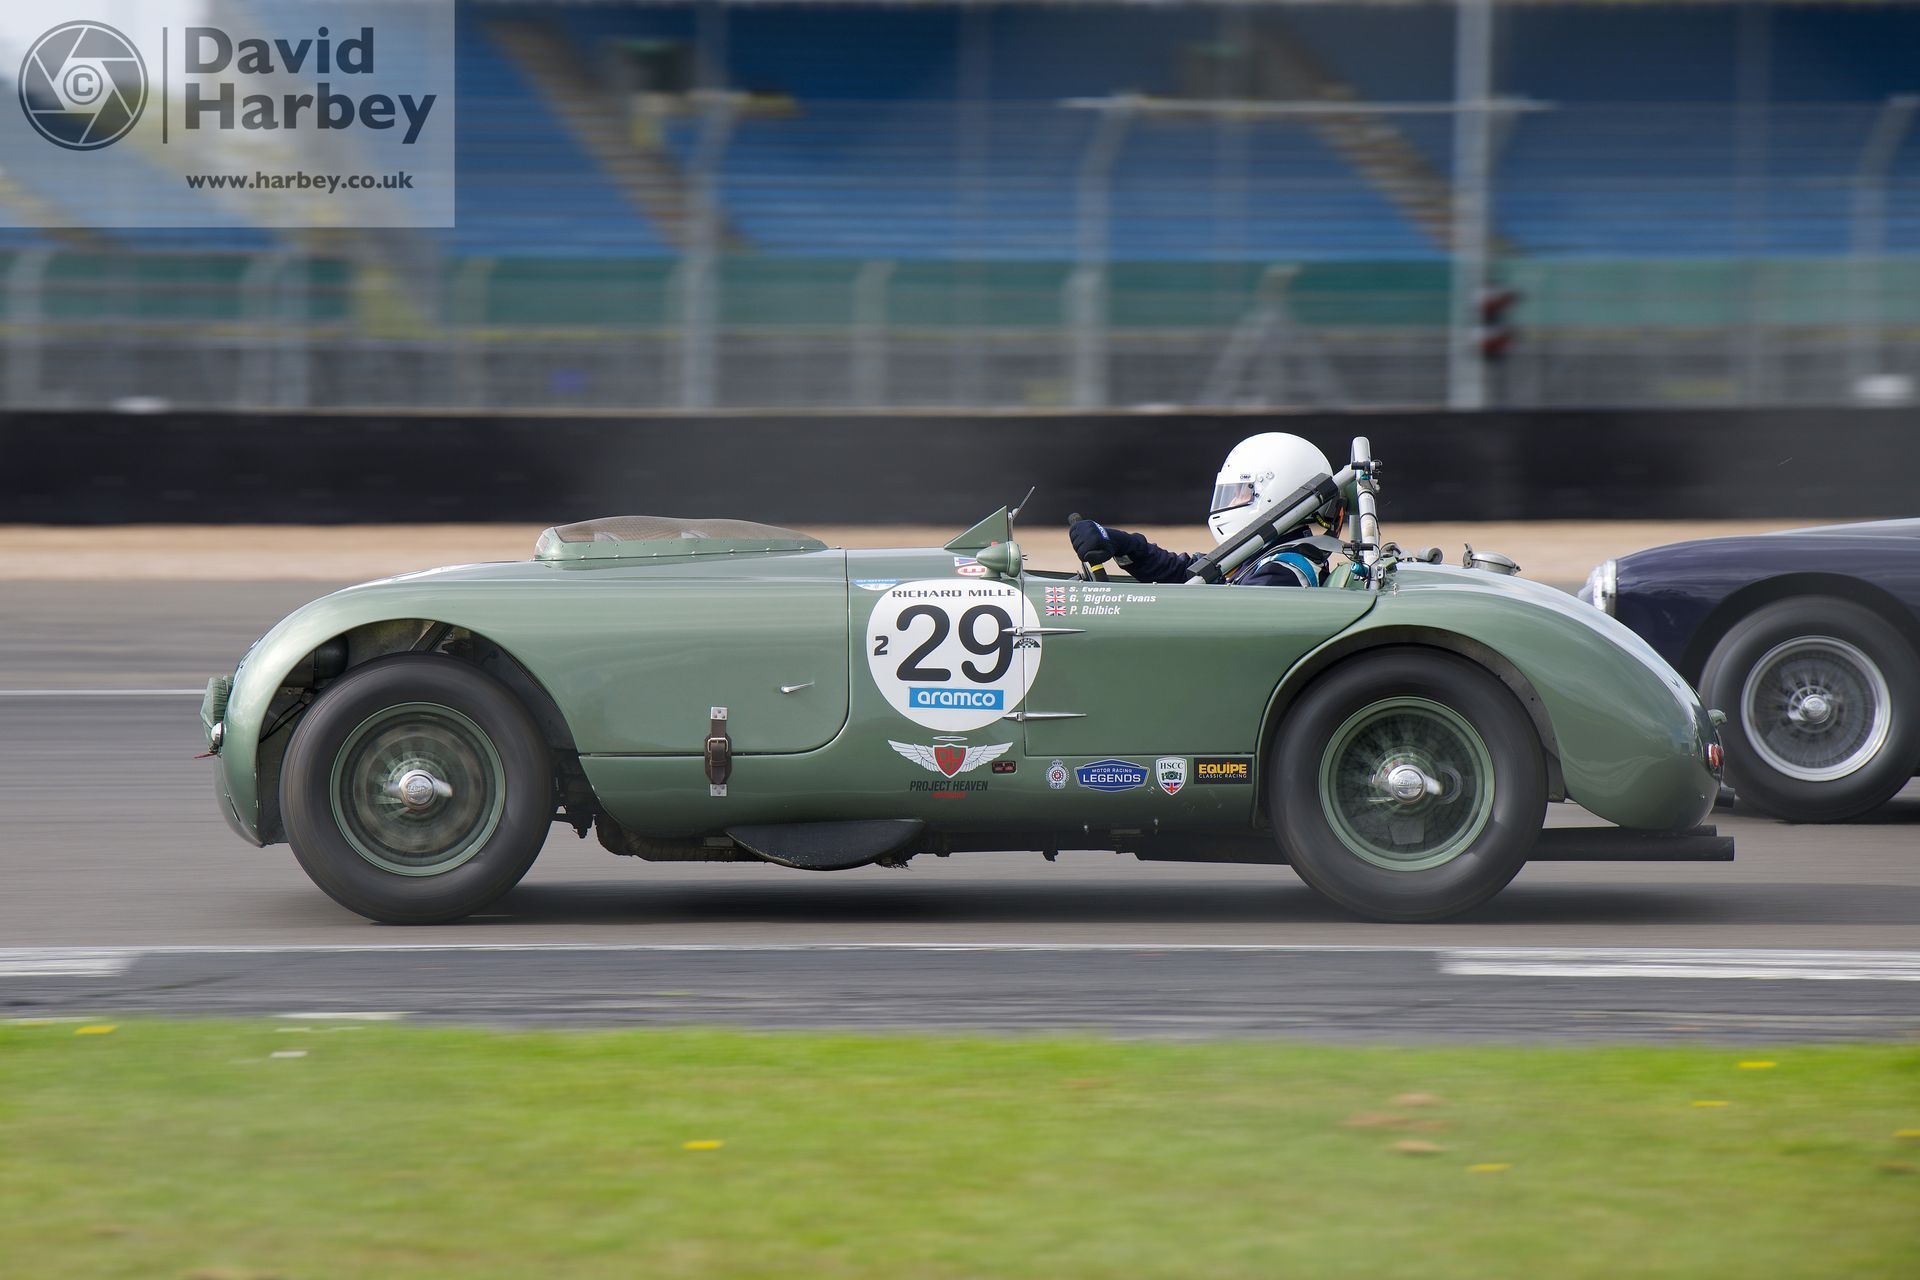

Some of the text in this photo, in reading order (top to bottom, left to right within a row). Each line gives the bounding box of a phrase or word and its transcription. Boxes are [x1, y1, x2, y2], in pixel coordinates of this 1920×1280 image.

[892, 589, 1016, 598] RICHARD MILLE
[1127, 595, 1157, 603] Evans
[1069, 605, 1121, 615] P. Bulbick
[874, 635, 889, 656] 2
[896, 604, 1014, 684] 29
[917, 691, 996, 707] aramco
[1160, 762, 1184, 770] HSCC
[1083, 774, 1141, 783] LEGENDS
[909, 780, 989, 792] PROJECT HEAVEN
